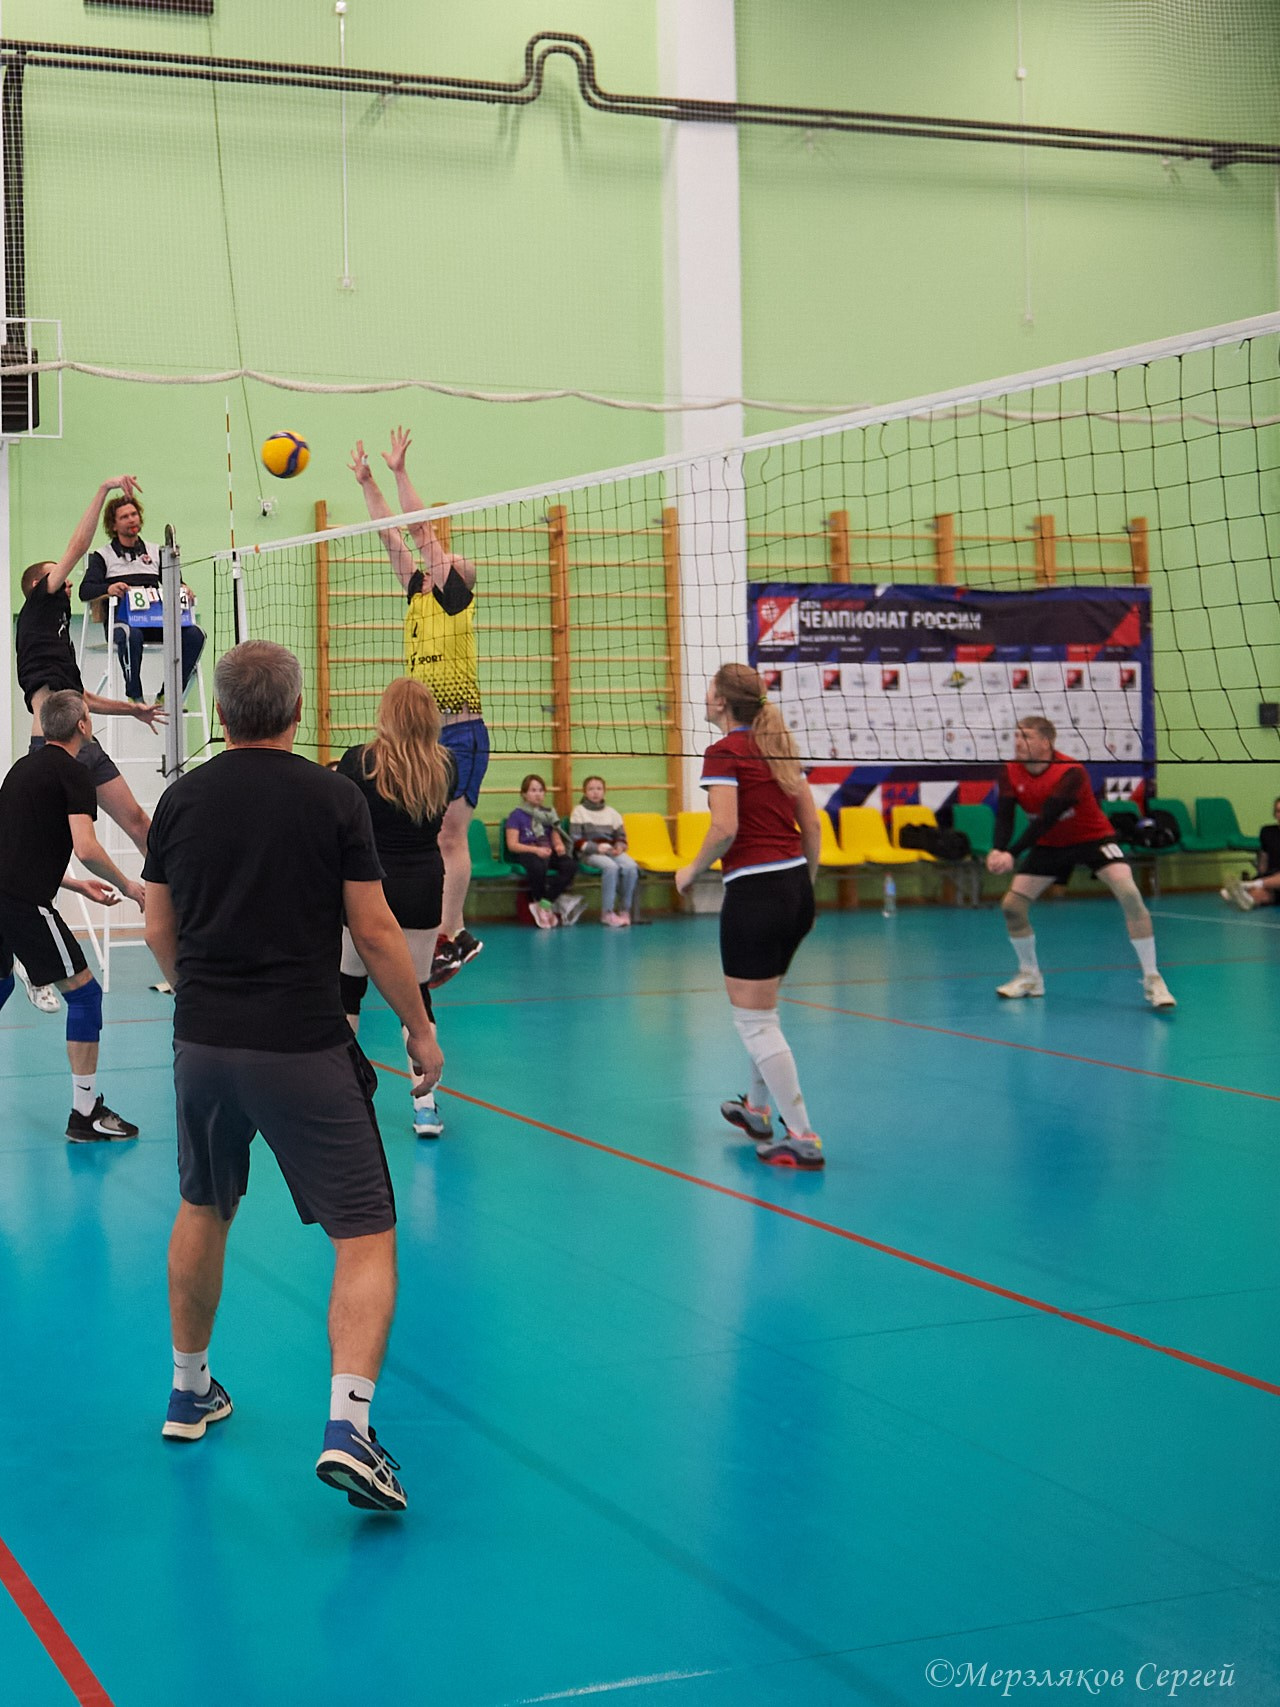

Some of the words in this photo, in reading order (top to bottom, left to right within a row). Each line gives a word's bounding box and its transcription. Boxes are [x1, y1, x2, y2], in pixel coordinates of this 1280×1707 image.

[133, 592, 146, 608] 8
[180, 595, 188, 608] 4
[799, 610, 909, 630] ЧЕМПИОНАТ
[911, 610, 982, 631] РОССИИ
